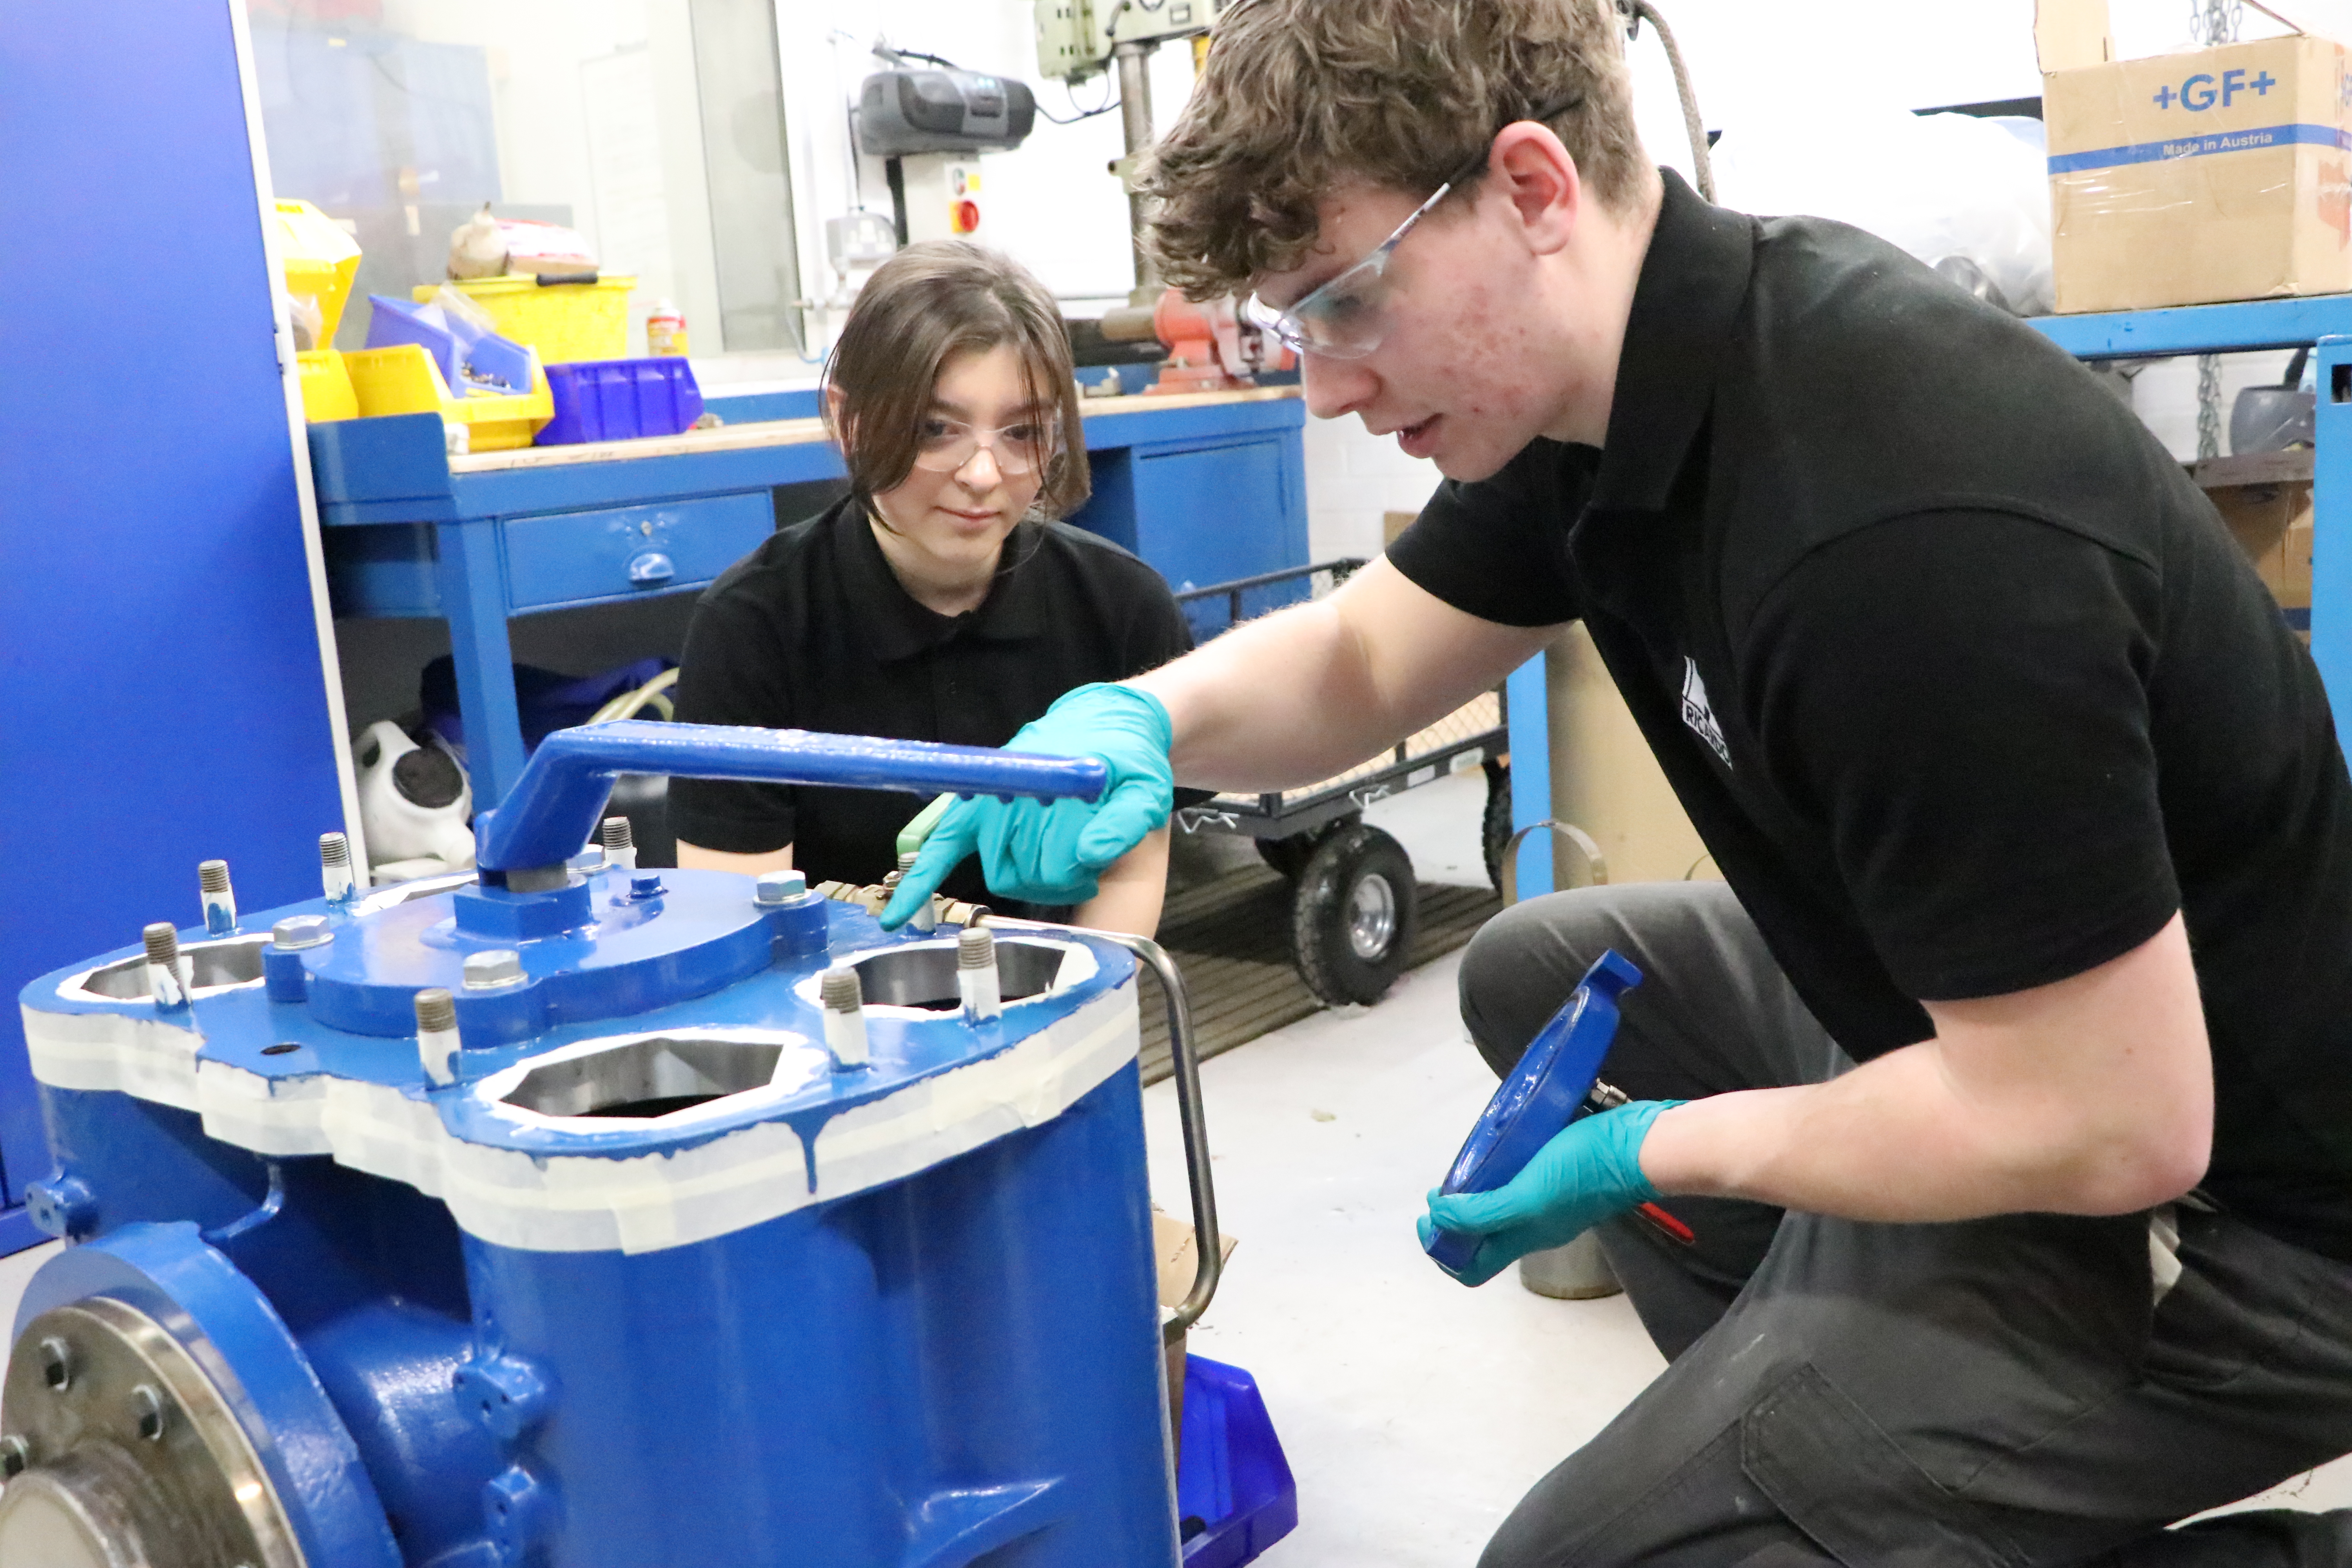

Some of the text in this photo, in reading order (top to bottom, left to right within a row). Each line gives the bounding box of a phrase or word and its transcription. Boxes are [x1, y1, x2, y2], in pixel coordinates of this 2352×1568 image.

[2163, 132, 2273, 156] Made in Austria
